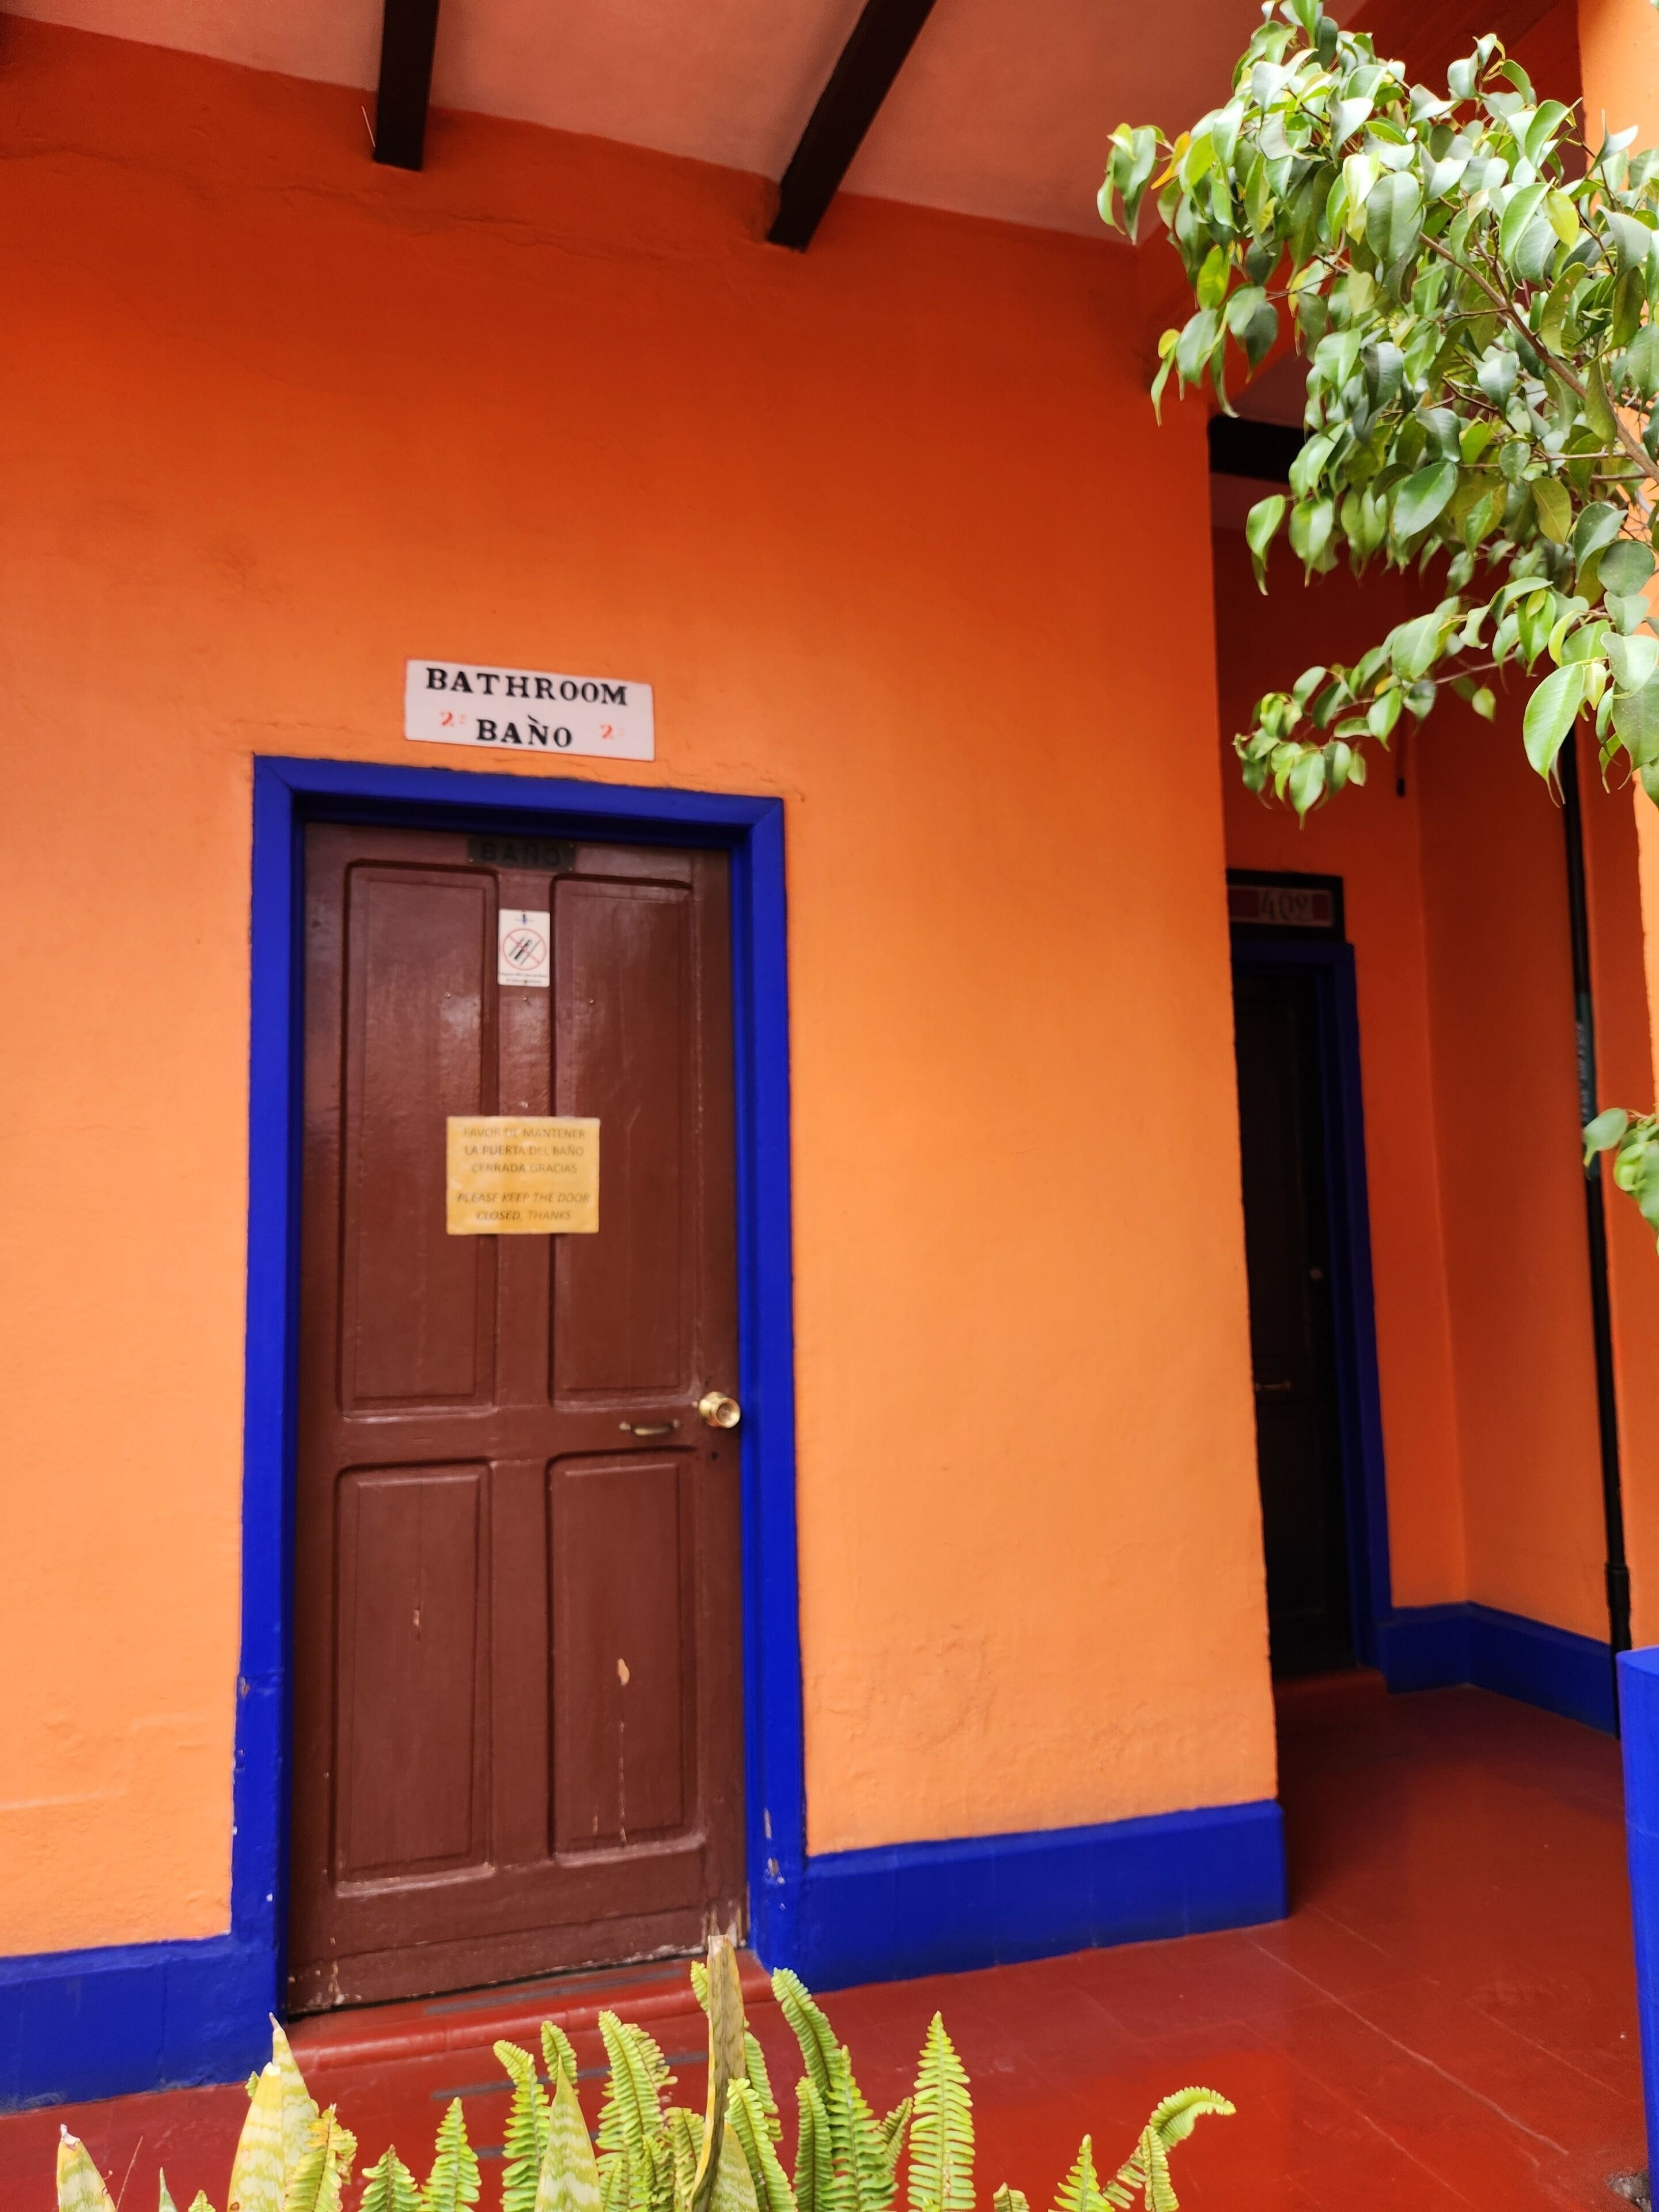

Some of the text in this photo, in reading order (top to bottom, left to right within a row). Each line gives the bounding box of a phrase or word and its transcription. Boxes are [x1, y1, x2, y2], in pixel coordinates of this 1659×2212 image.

[426, 668, 628, 706] BATHROOM
[476, 715, 572, 748] BAÑO
[464, 1127, 585, 1139] FAVOR DE MANTENER
[465, 1143, 584, 1157] LA PUERTA DEL BAÑO
[472, 1162, 578, 1173] CERRADA GRACIAS
[457, 1192, 590, 1203] PLEASE KEEP THE DOOR
[476, 1210, 572, 1222] CLOSED, THANKS
